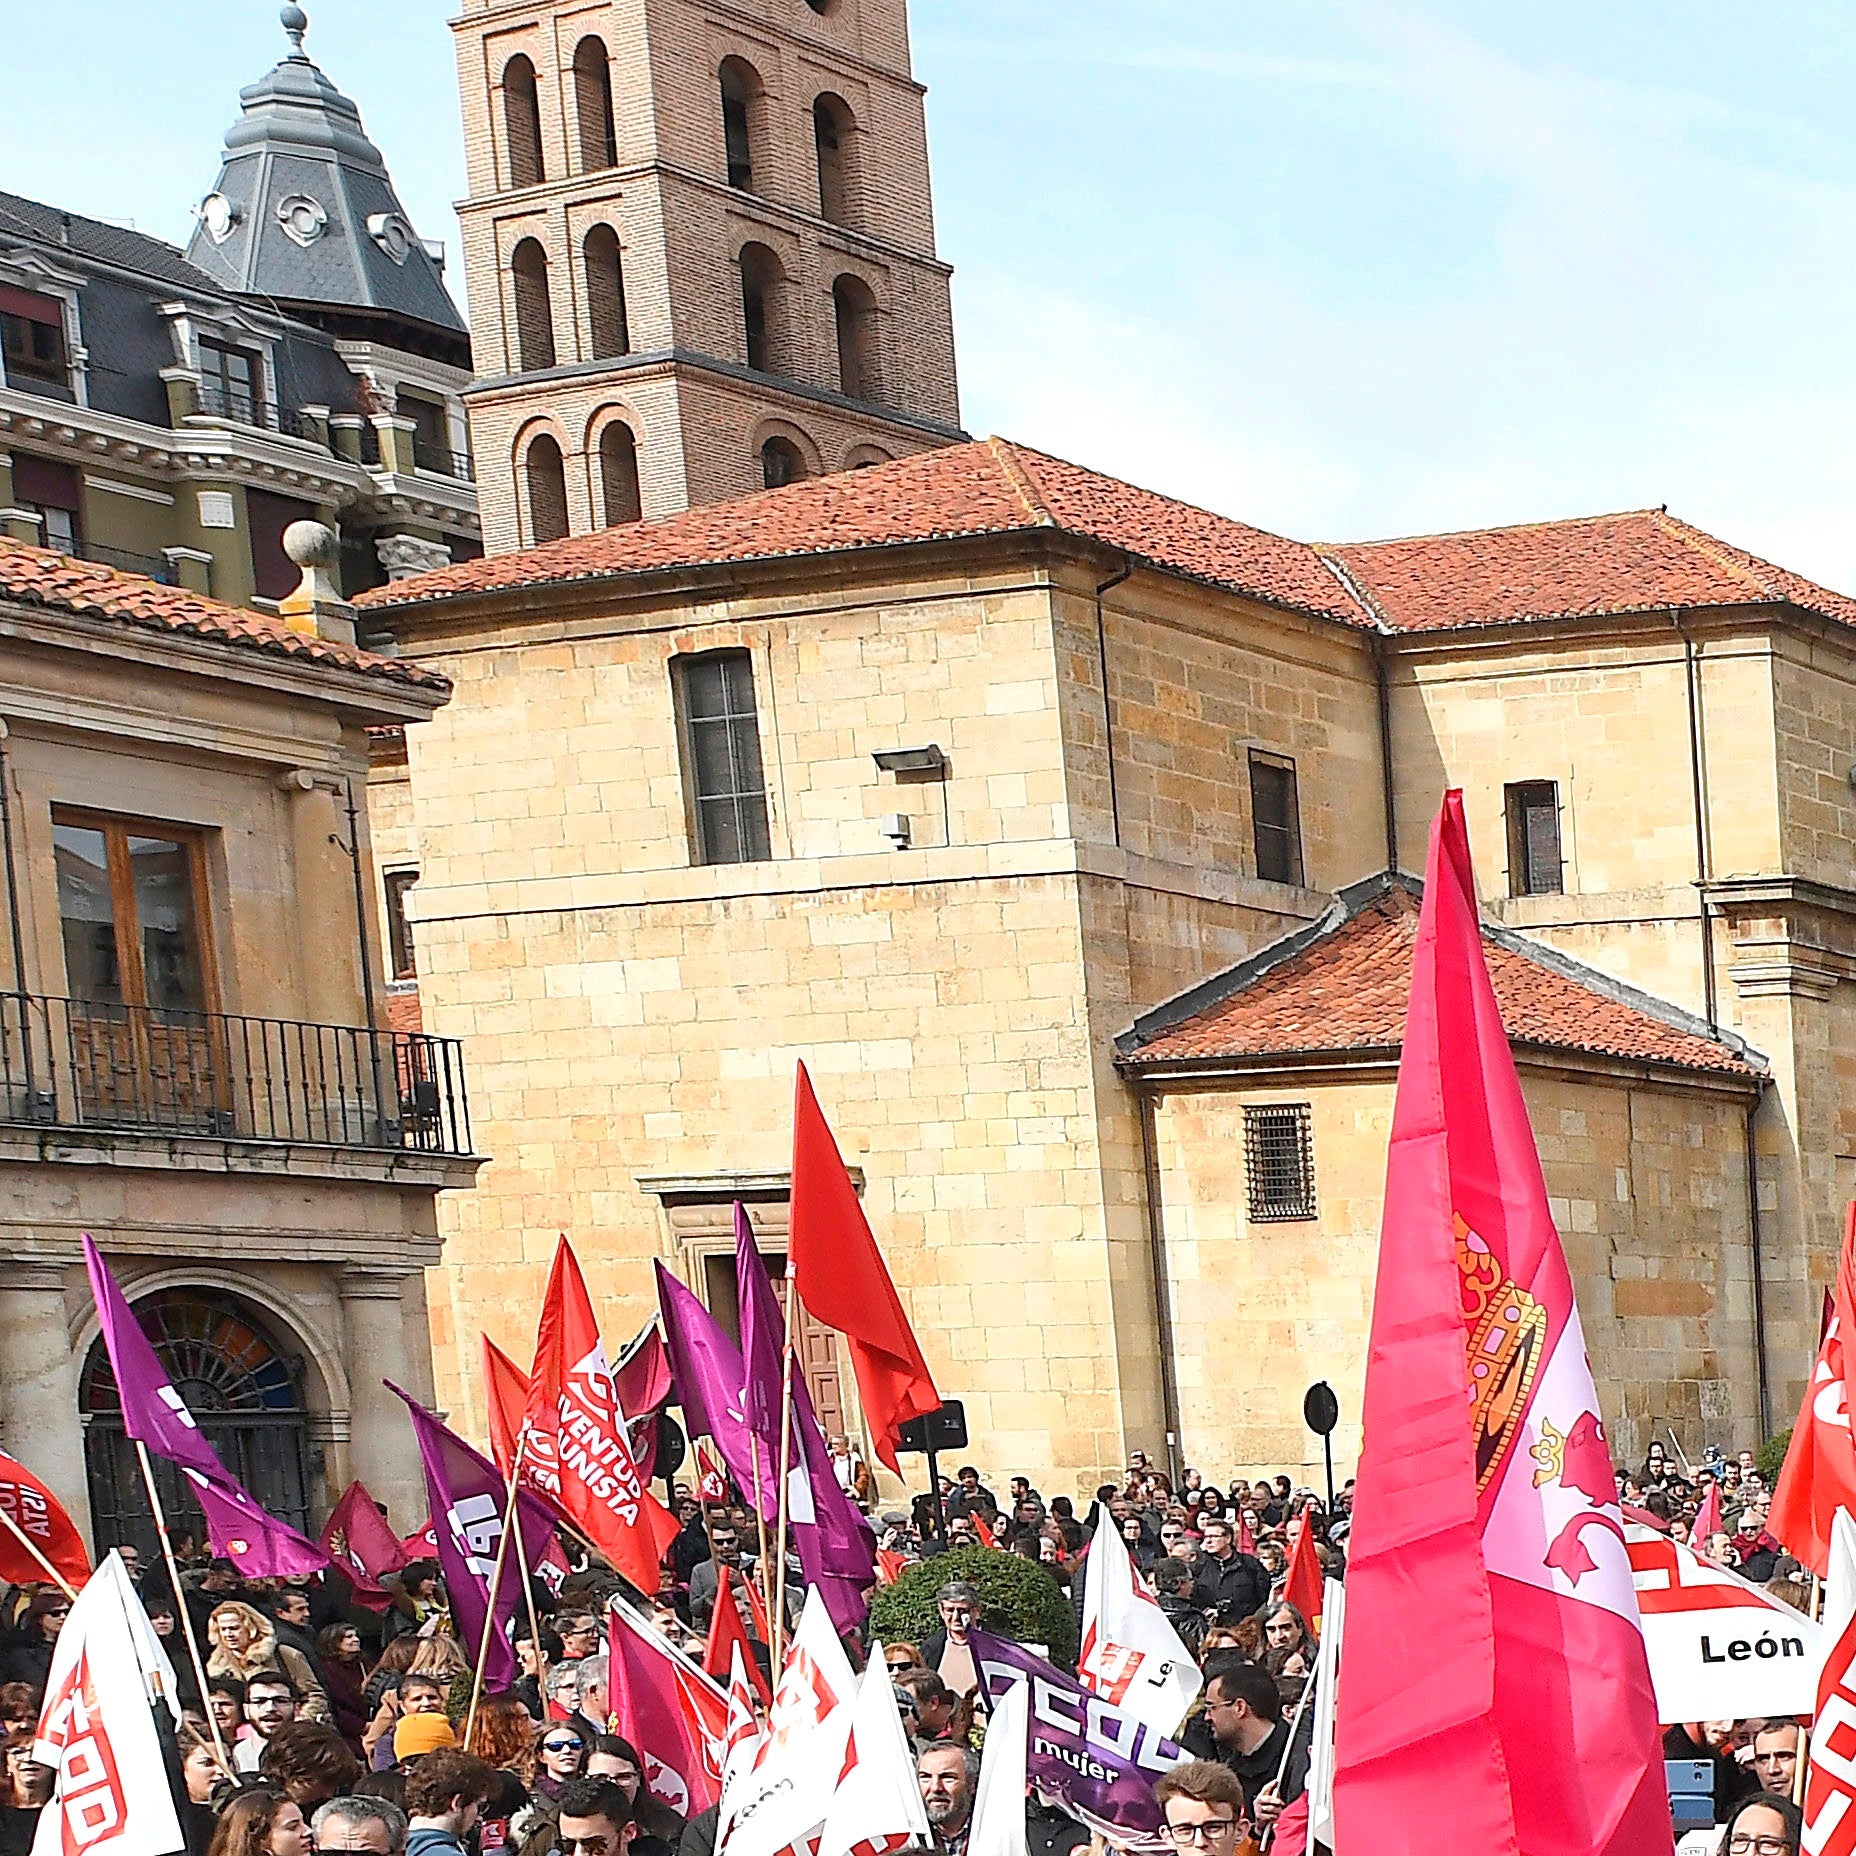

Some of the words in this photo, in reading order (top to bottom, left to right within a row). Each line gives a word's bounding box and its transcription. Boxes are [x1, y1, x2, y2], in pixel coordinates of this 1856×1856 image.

[559, 1394, 642, 1498] VENTUD
[559, 1428, 640, 1527] UNISTA
[1700, 1630, 1805, 1663] León
[1034, 1736, 1119, 1784] mujer
